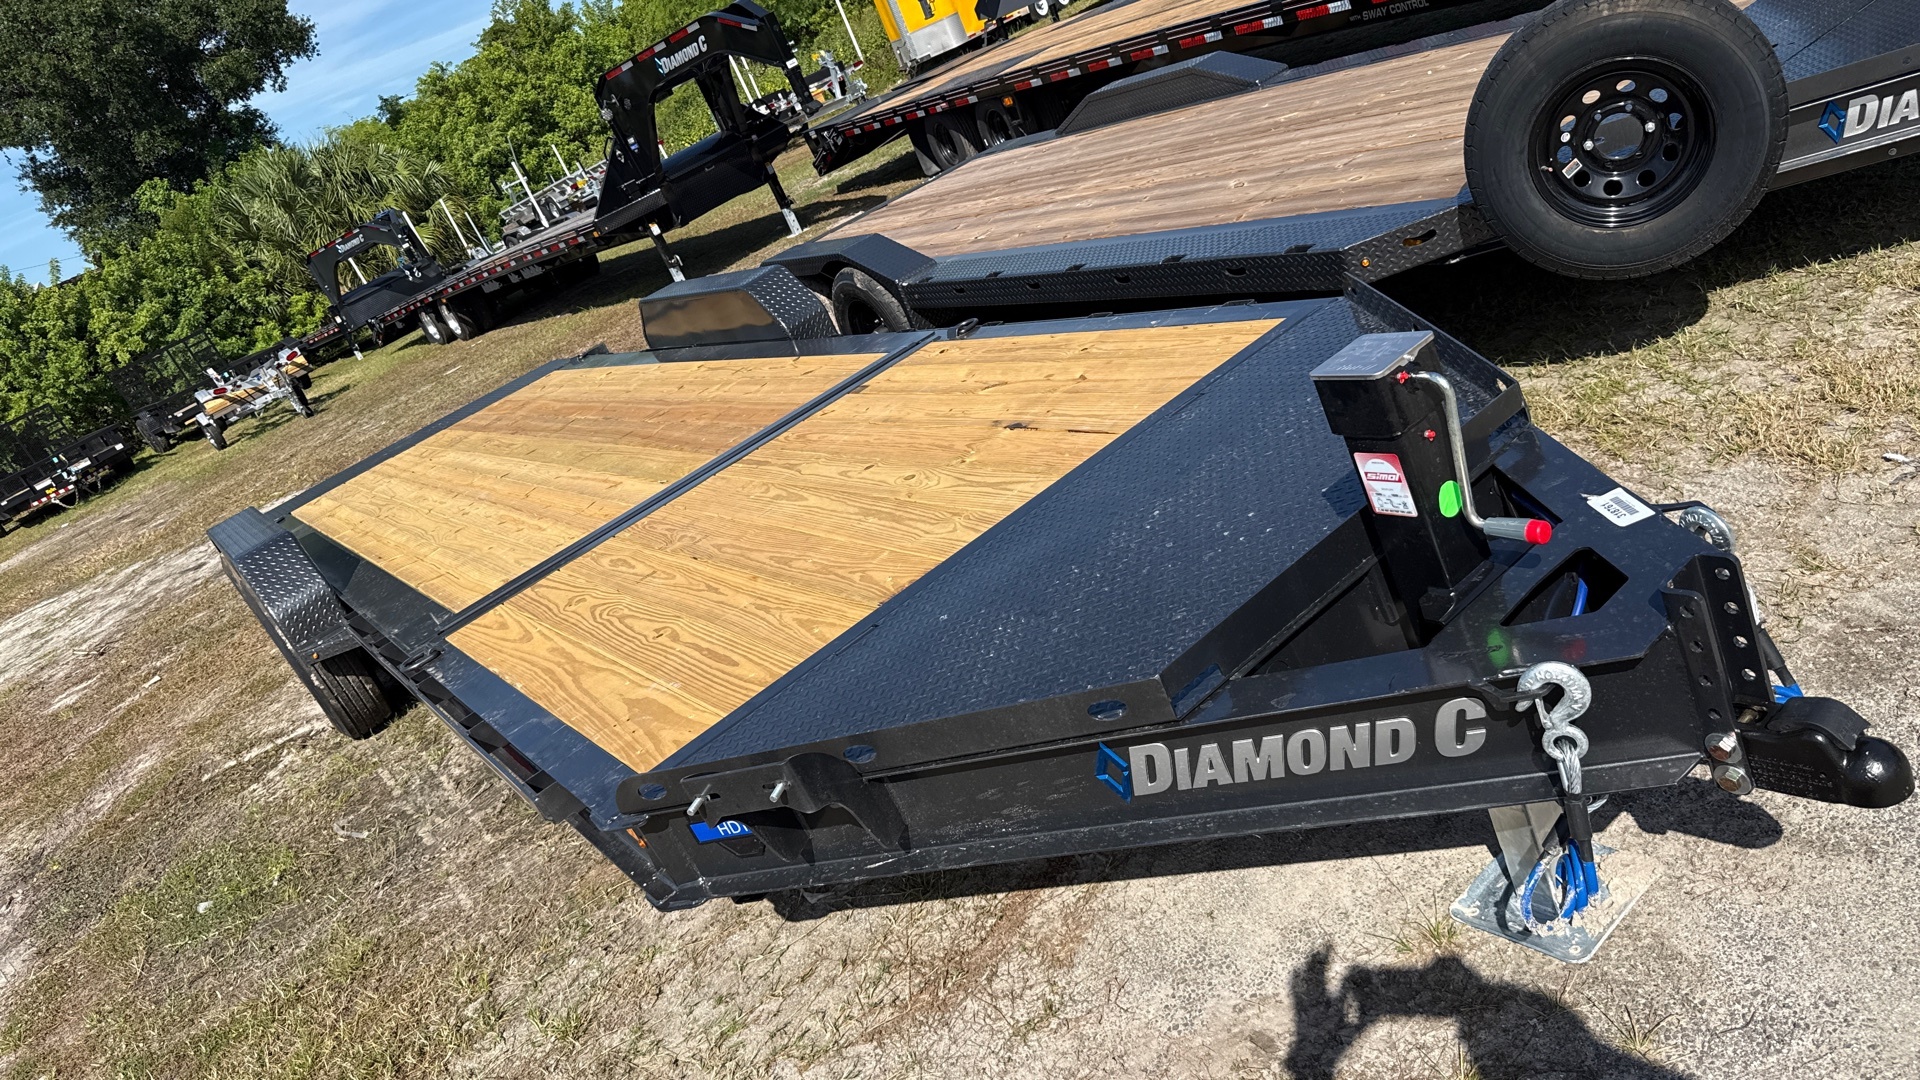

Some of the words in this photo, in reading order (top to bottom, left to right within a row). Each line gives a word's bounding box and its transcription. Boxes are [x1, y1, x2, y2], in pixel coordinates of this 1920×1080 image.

[1362, 6, 1388, 20] SWAY
[1389, 0, 1429, 14] CONTROL
[660, 42, 700, 74] DIAMOND
[698, 35, 708, 52] C
[1843, 88, 1919, 138] DIA
[1128, 717, 1417, 796] DIAMOND
[1434, 697, 1487, 757] C
